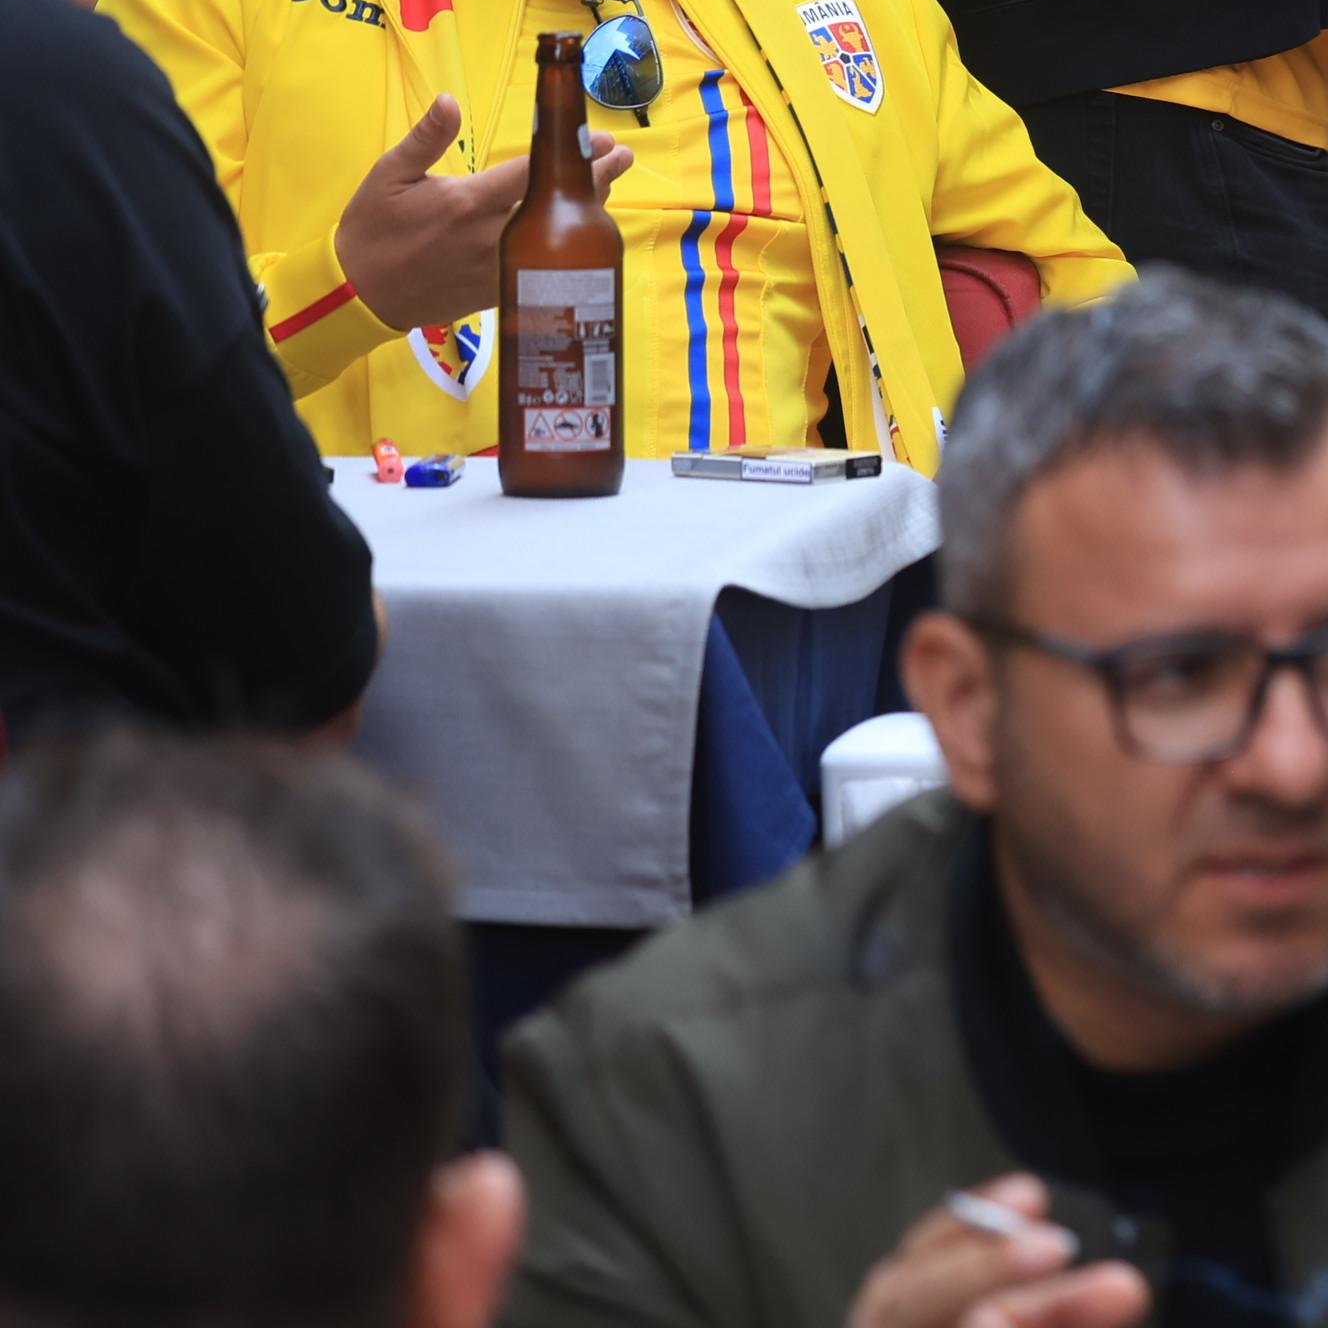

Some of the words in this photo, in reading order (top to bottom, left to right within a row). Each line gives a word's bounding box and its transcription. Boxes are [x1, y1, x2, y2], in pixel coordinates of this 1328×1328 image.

[800, 0, 855, 27] MÂNIA
[743, 462, 782, 476] Fumatul
[783, 465, 811, 477] ucide
